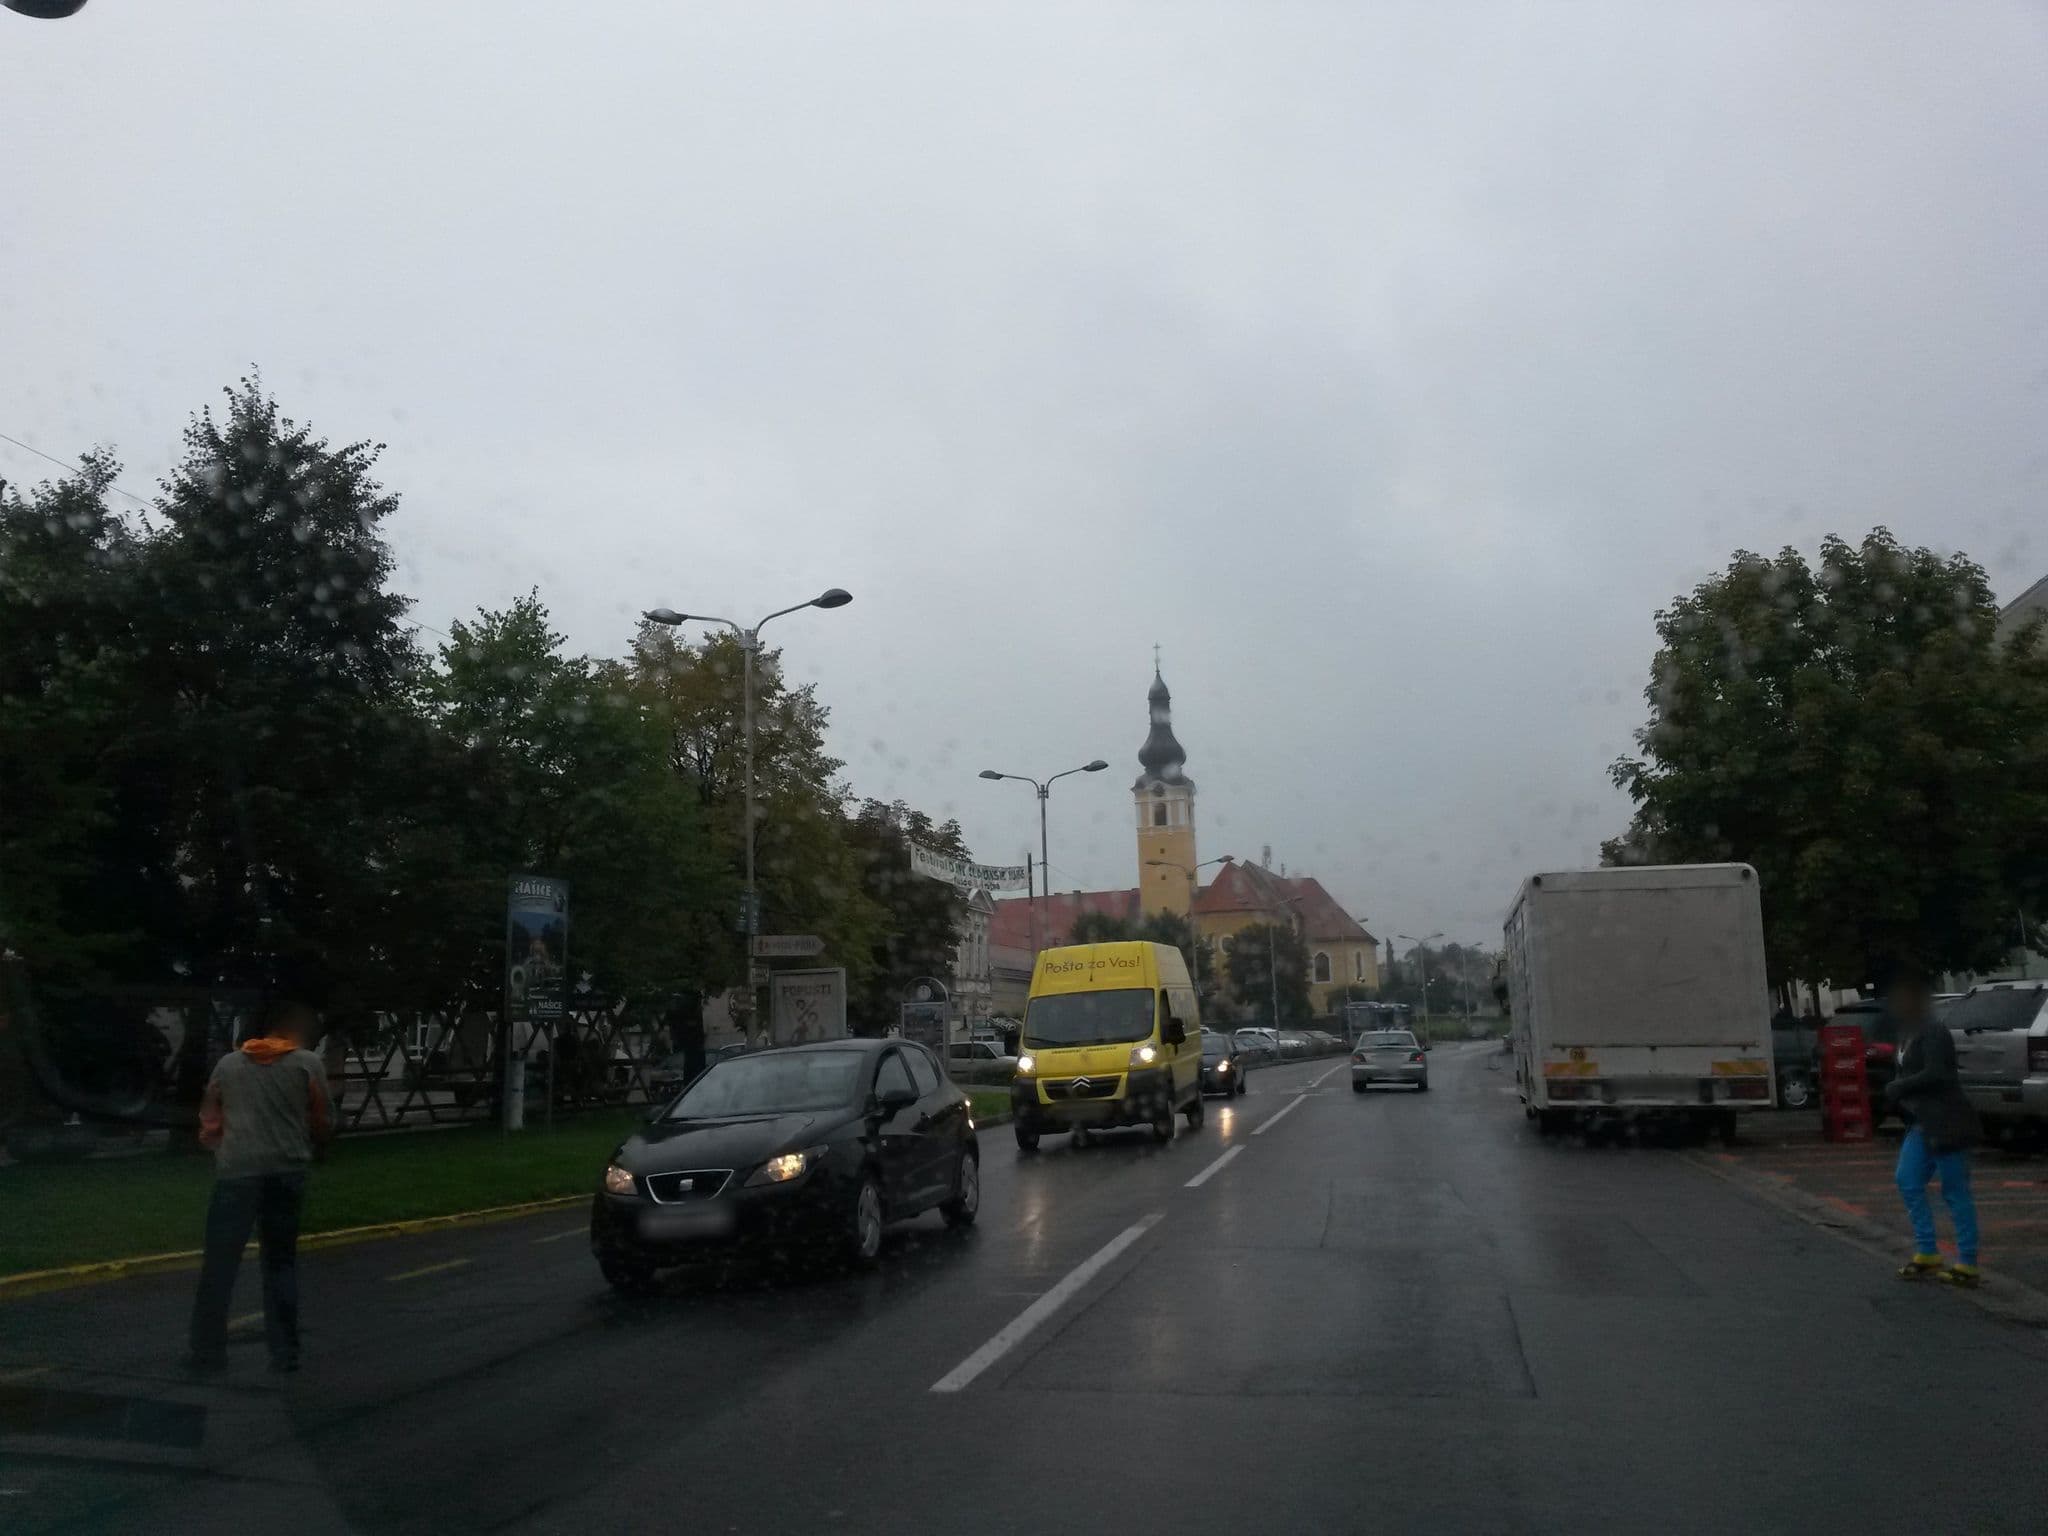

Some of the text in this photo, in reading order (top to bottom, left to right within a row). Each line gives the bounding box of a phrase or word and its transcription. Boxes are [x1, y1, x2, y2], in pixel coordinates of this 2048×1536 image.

[1045, 956, 1140, 975] Pošta za Vas!
